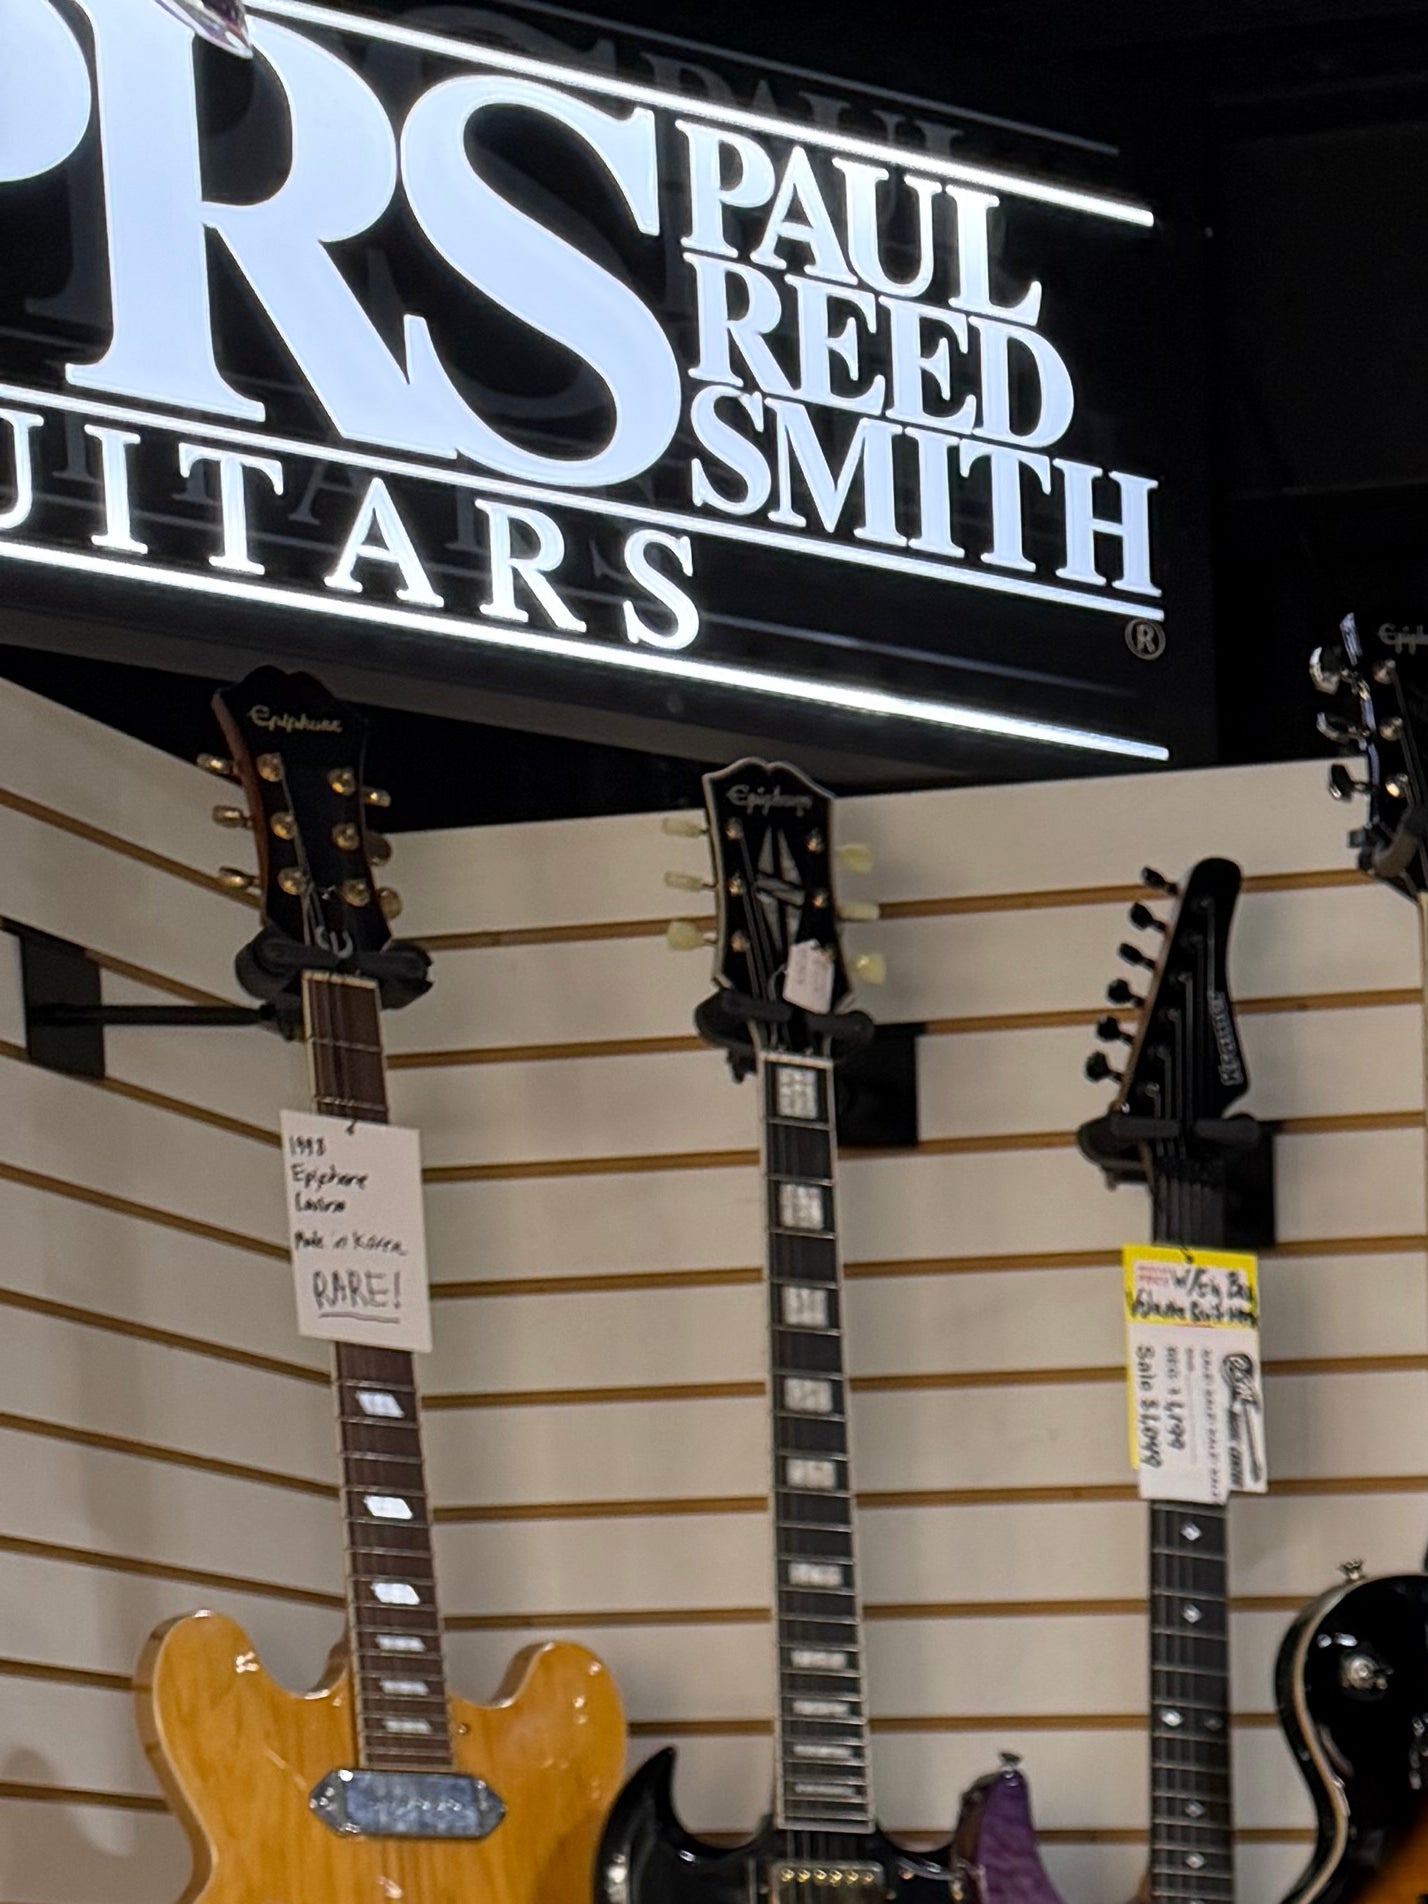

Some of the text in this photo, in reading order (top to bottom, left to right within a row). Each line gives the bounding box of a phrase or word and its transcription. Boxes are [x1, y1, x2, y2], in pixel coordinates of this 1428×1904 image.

[676, 117, 1043, 326] PAUL
[683, 250, 1075, 450] REED
[690, 384, 1163, 598] SMITH
